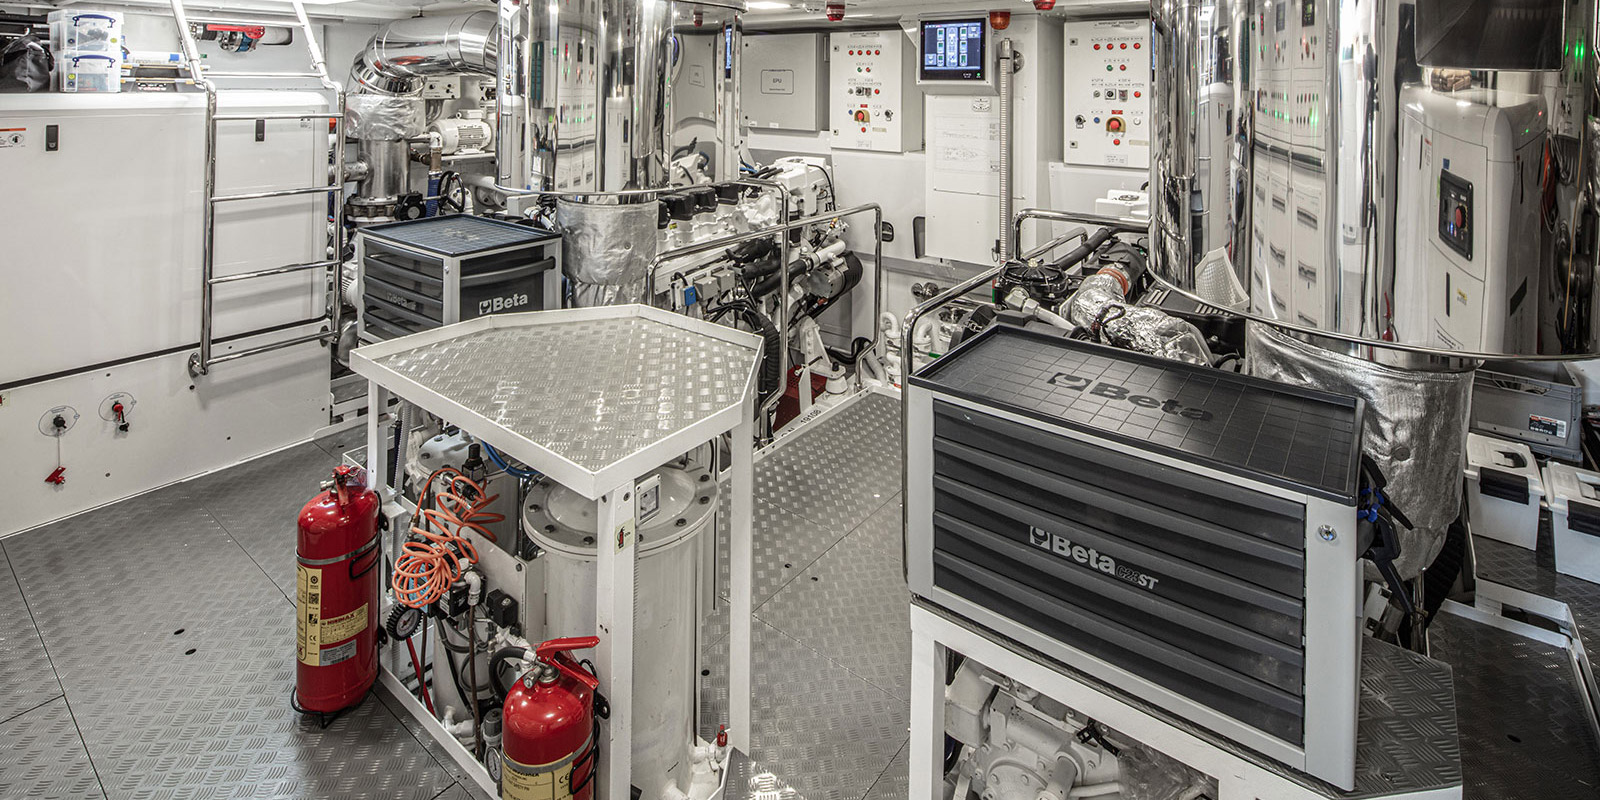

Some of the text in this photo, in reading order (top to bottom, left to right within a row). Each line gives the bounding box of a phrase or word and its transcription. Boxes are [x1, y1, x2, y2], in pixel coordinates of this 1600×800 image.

[493, 293, 528, 312] Beta
[1089, 381, 1213, 422] Beta
[1052, 534, 1116, 576] Beta
